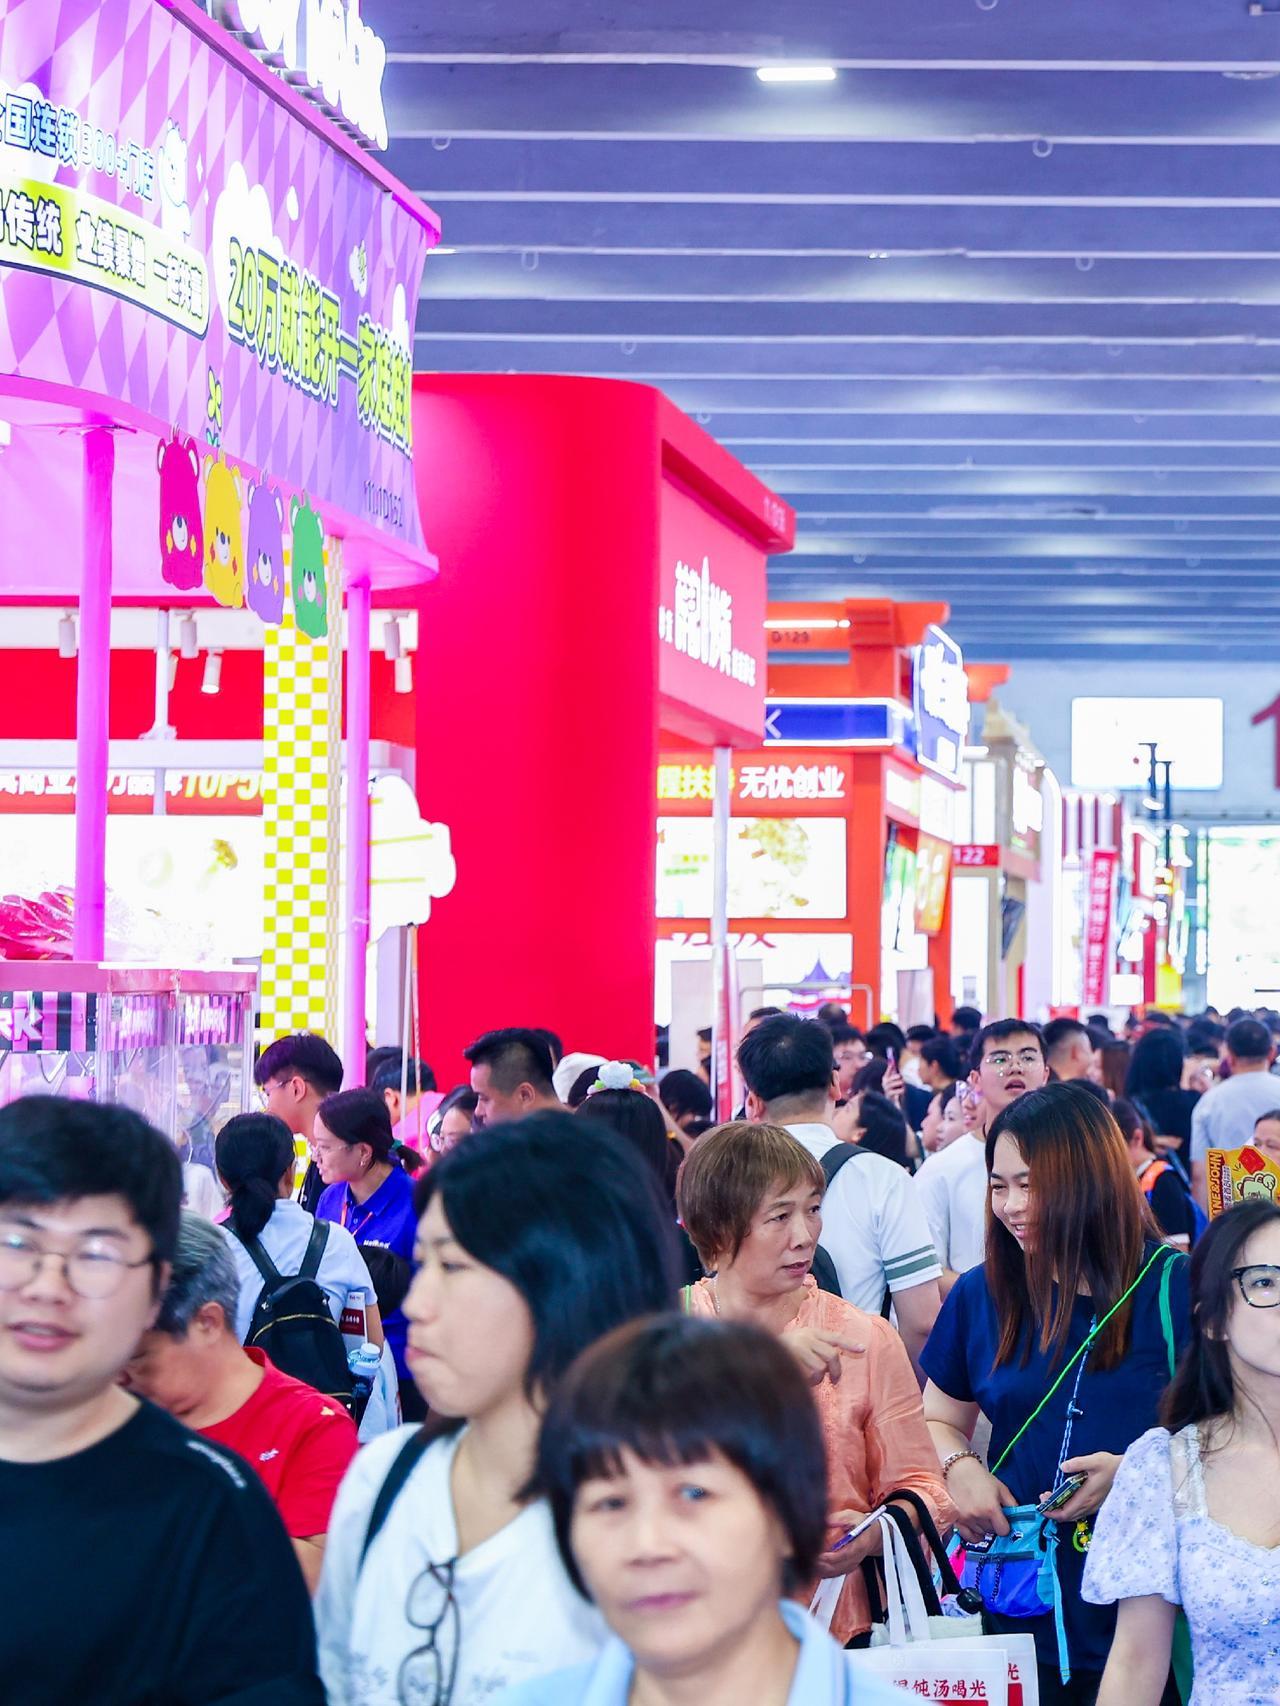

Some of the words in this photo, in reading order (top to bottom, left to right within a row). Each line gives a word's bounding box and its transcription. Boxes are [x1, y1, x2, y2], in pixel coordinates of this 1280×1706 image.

[0, 93, 154, 201] 国连锁300+门店
[0, 189, 63, 257] 传统
